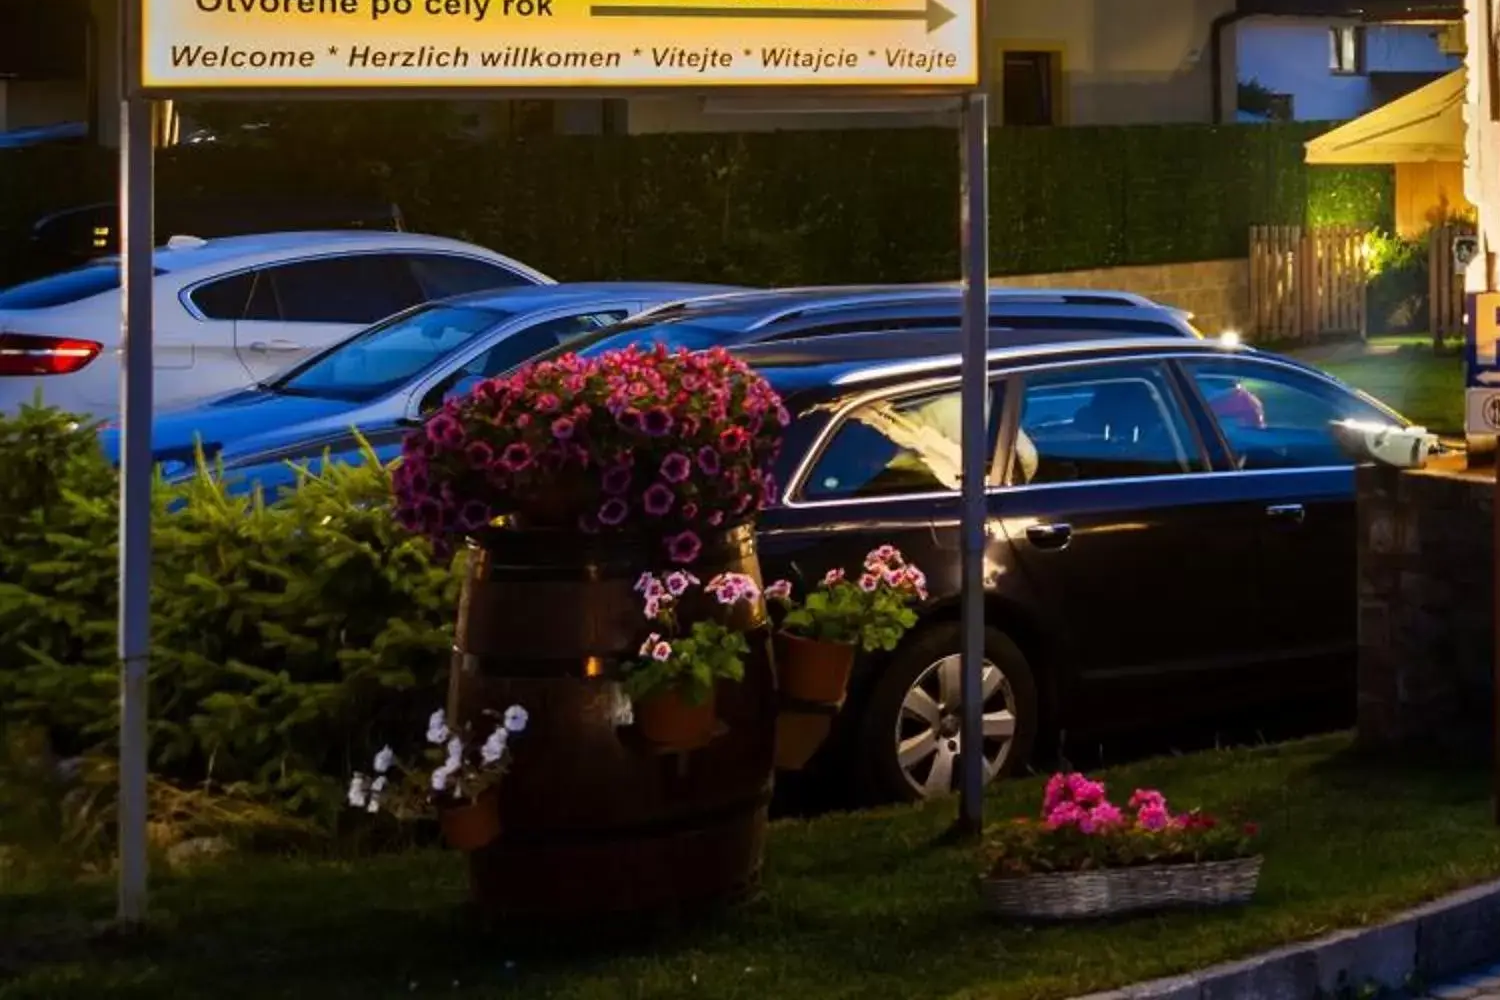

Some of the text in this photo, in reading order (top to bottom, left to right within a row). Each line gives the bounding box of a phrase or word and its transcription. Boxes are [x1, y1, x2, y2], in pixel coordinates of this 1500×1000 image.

[170, 45, 315, 68] Welcome
[348, 46, 470, 68] Herzlich
[480, 46, 621, 68] willkomen
[761, 47, 858, 73] Witajcie
